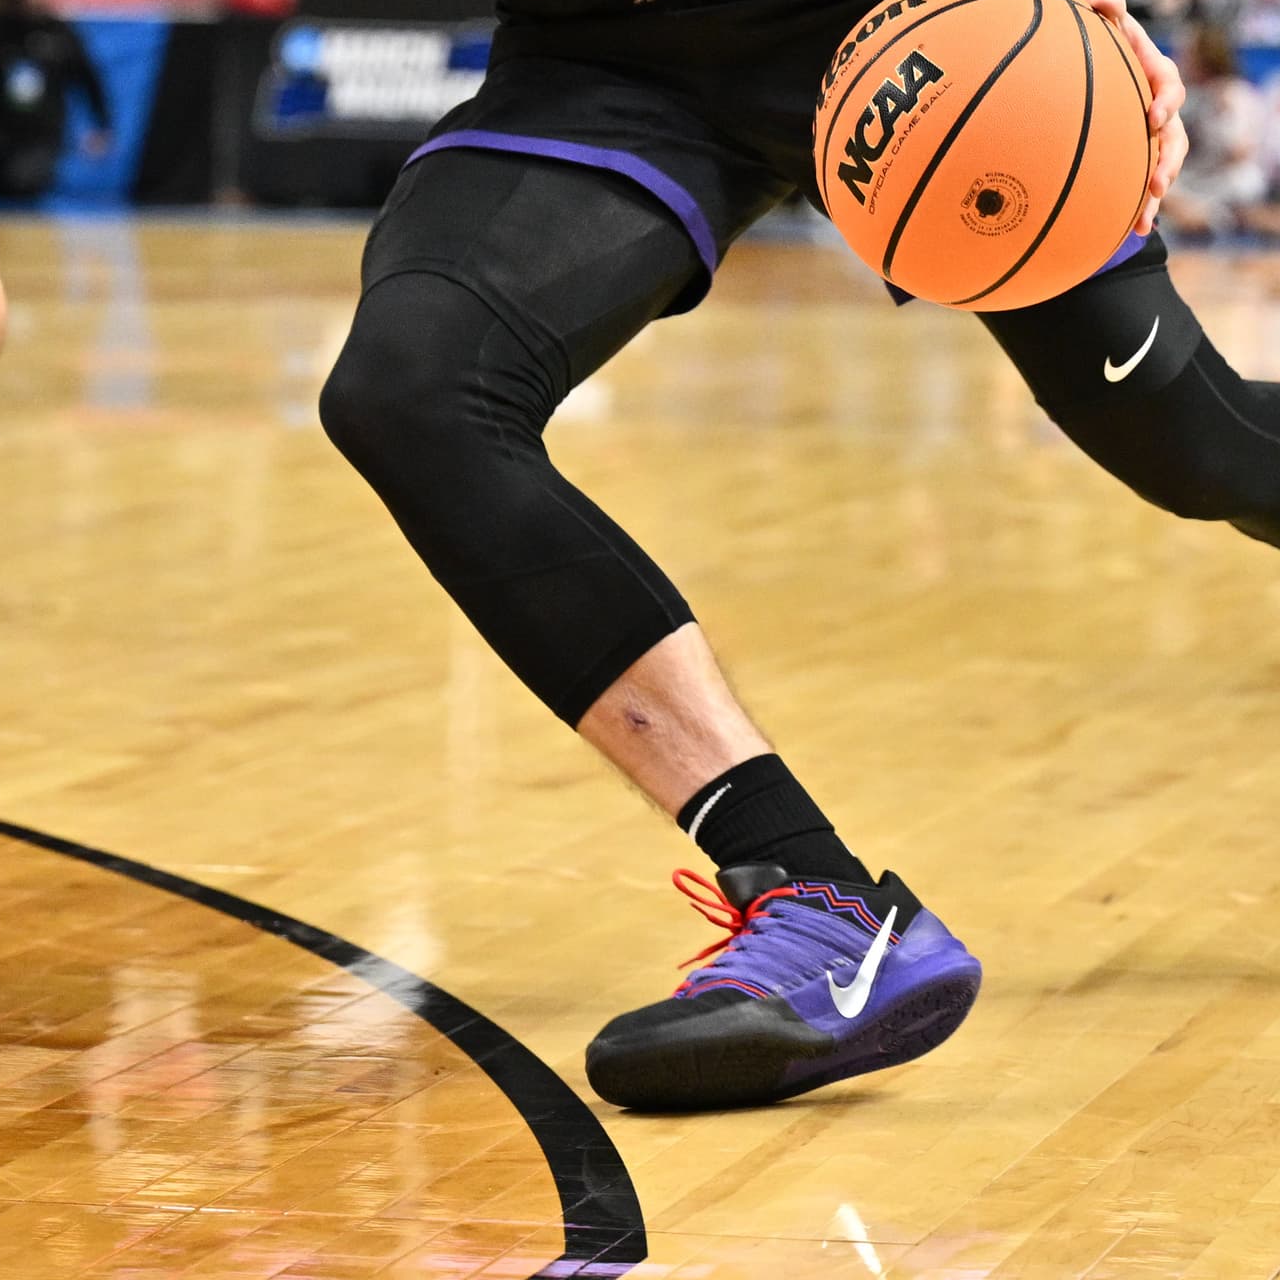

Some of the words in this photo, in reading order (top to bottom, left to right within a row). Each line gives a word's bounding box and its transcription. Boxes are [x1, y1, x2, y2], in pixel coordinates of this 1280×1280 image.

[837, 50, 945, 207] NCAA
[868, 158, 895, 216] OFFICIAL
[891, 115, 921, 156] GAME
[920, 81, 954, 115] BALL
